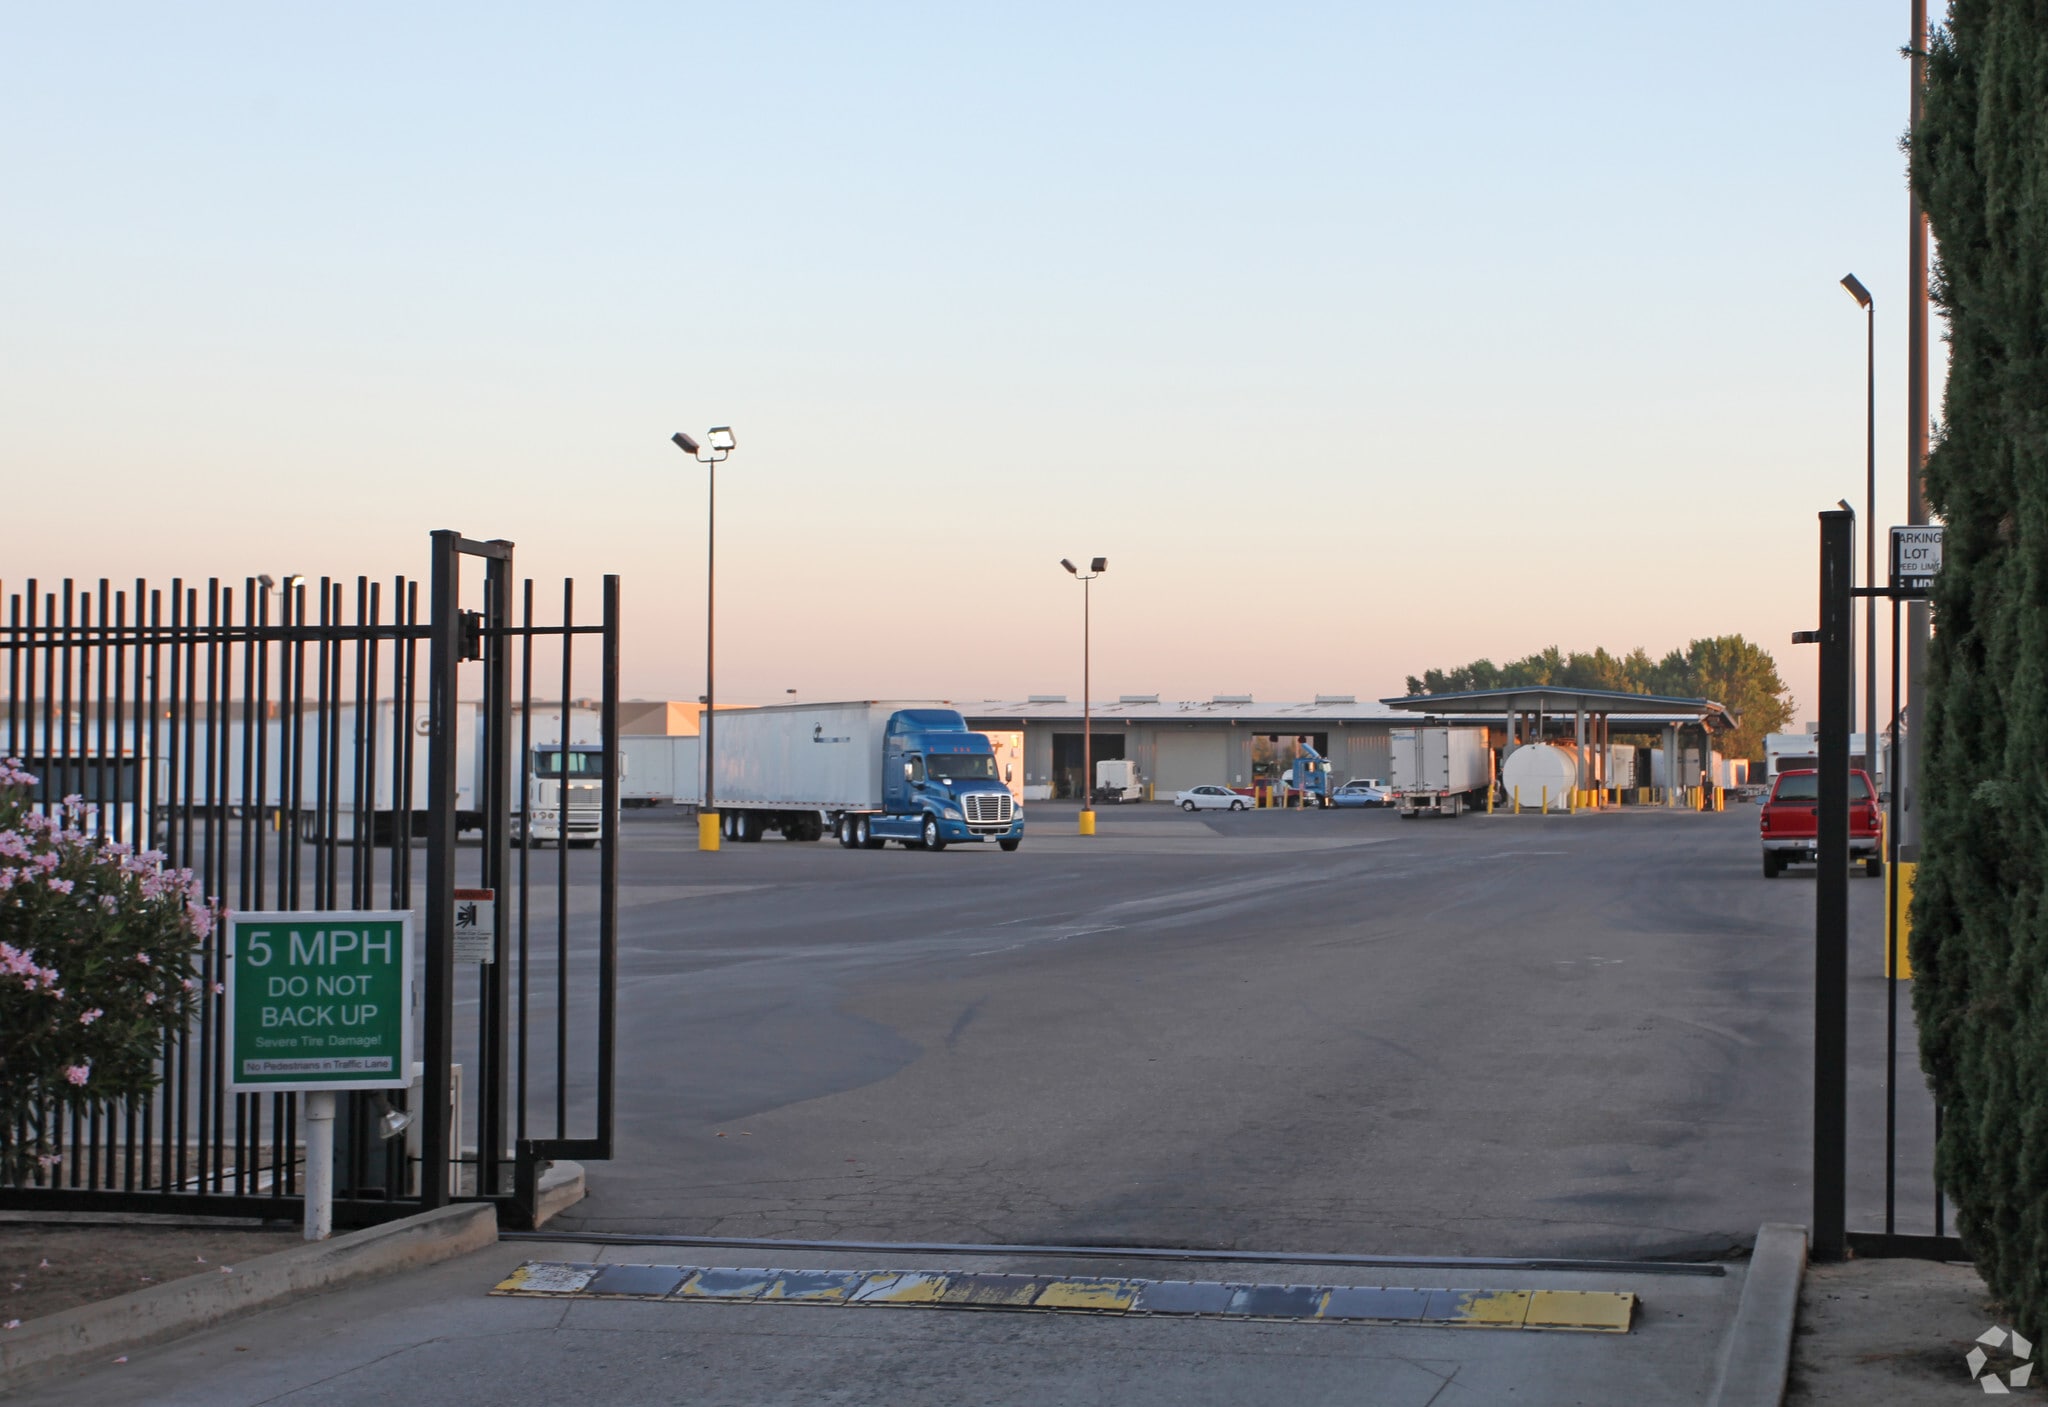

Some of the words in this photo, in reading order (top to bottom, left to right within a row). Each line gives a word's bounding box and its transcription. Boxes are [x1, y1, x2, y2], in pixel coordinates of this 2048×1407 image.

[1899, 533, 1942, 543] ARKING
[1904, 548, 1928, 559] LOT
[247, 931, 272, 967] 5
[289, 929, 392, 966] MPH
[268, 976, 308, 997] DO
[316, 975, 373, 996] NOT
[261, 1005, 334, 1027] BACK
[341, 1004, 378, 1026] UP
[255, 1036, 298, 1048] Severe
[301, 1035, 324, 1046] Tire
[328, 1034, 382, 1048] Damage!
[246, 1063, 261, 1071] No
[263, 1060, 320, 1070] Pedestrians
[364, 1059, 389, 1069] Lane
